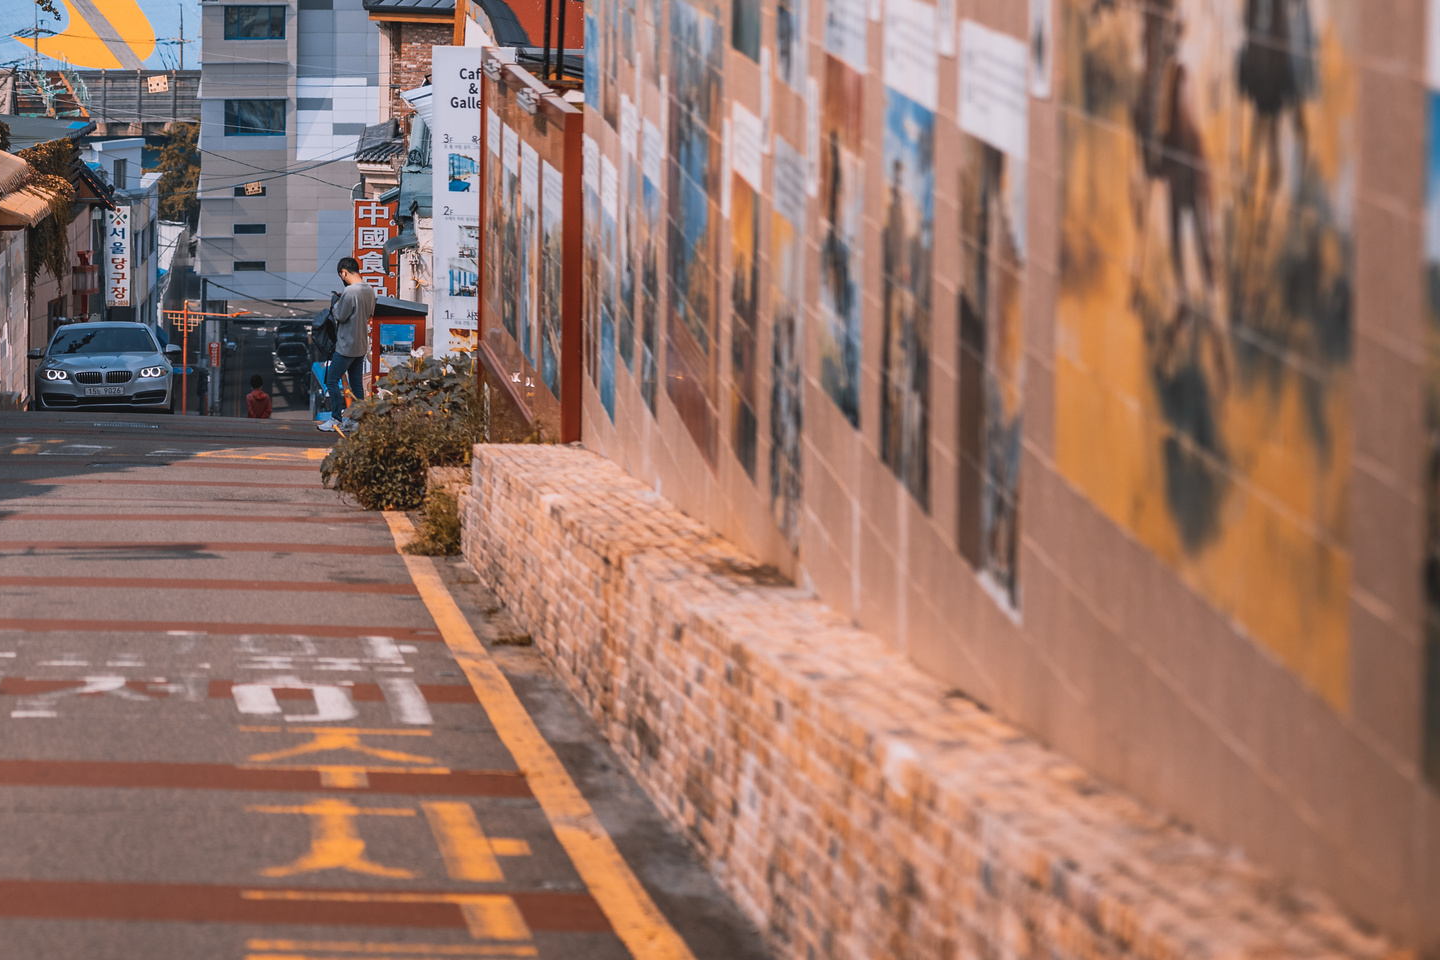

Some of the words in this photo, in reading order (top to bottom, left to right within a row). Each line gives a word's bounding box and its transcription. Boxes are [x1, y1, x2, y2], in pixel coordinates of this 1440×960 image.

[459, 67, 481, 80] Caf
[468, 82, 479, 95] &
[450, 96, 481, 110] Galle
[109, 227, 128, 300] 서울당구장
